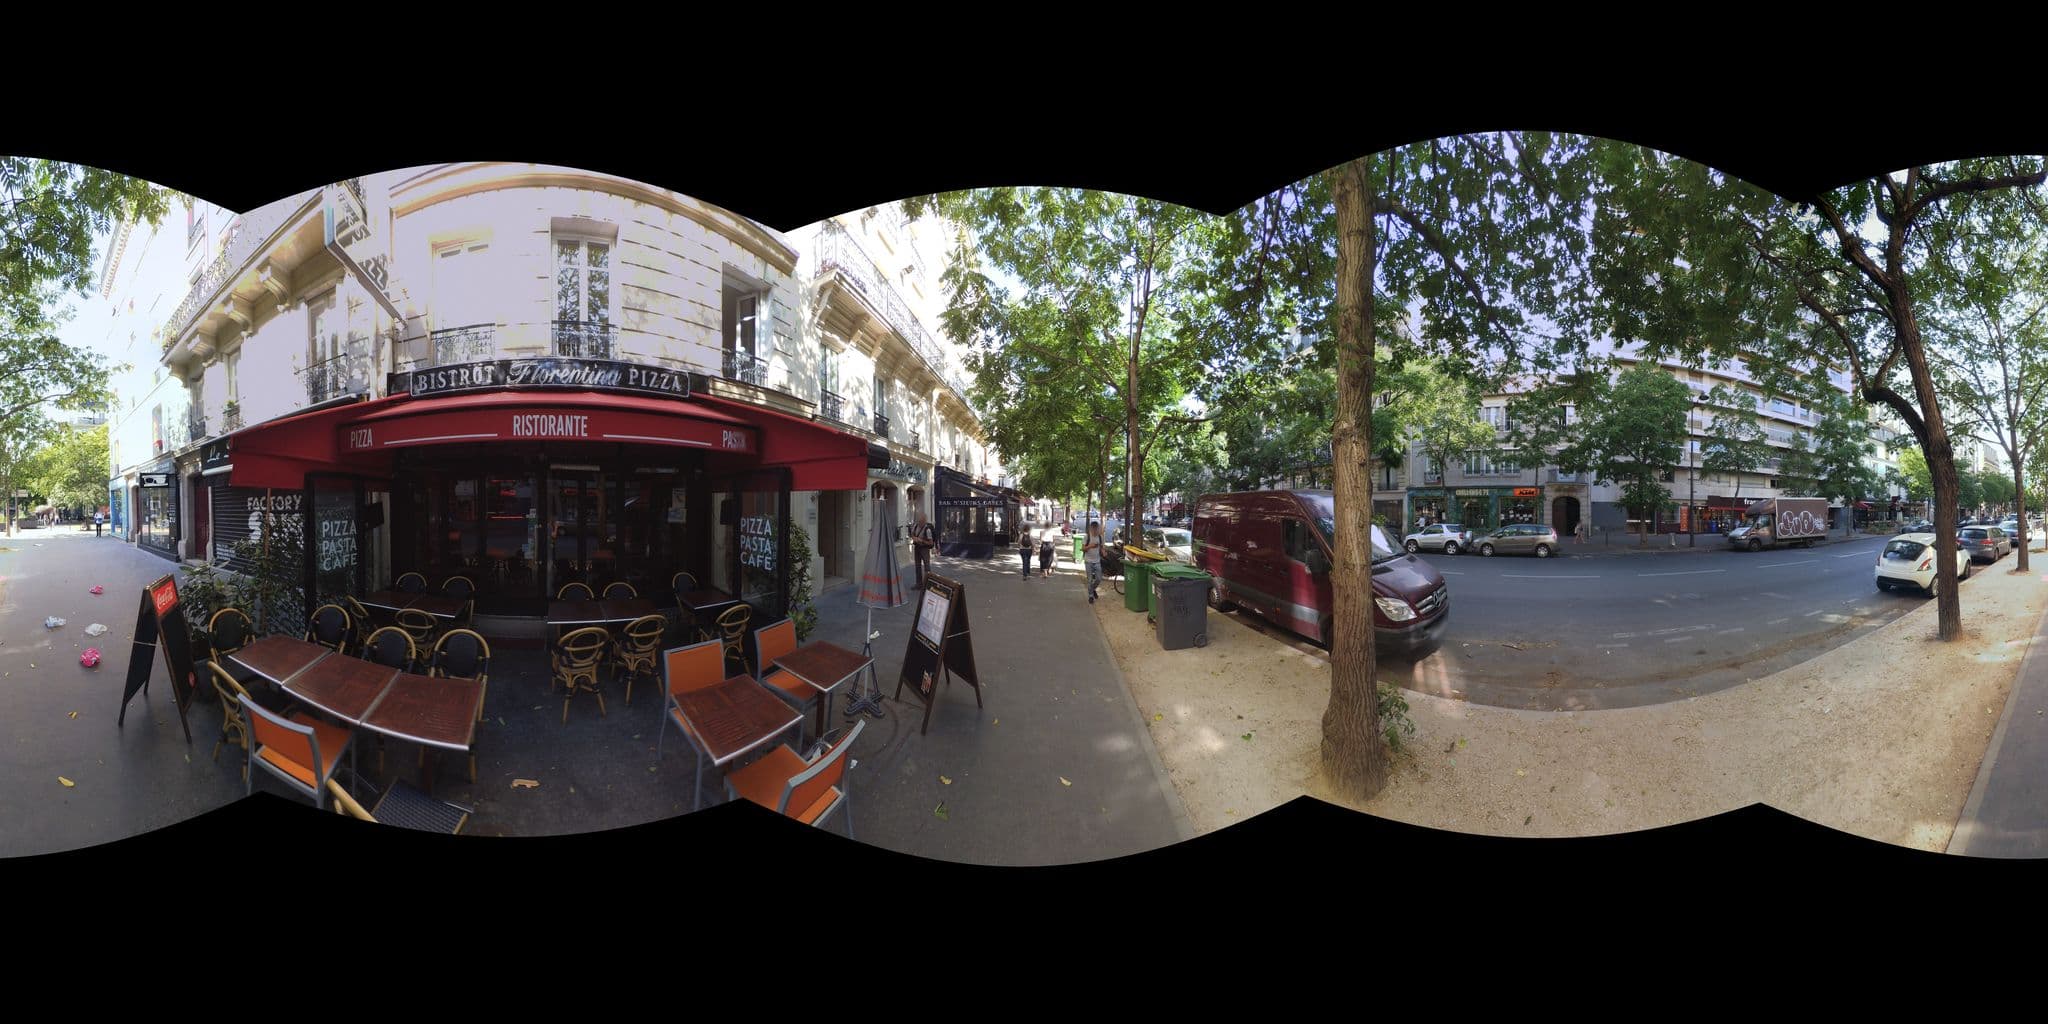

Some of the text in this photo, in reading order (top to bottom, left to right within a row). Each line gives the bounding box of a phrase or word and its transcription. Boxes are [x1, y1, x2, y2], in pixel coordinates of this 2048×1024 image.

[628, 367, 682, 392] PIZZA
[513, 415, 588, 437] RISTORANTE
[350, 429, 373, 448] PIZZA
[722, 430, 746, 449] PASTA
[247, 495, 303, 511] FACTORY
[322, 520, 357, 538] PIZZA
[740, 518, 772, 536] PIZZA
[322, 537, 358, 556] PASTA
[740, 535, 772, 555] PASTA
